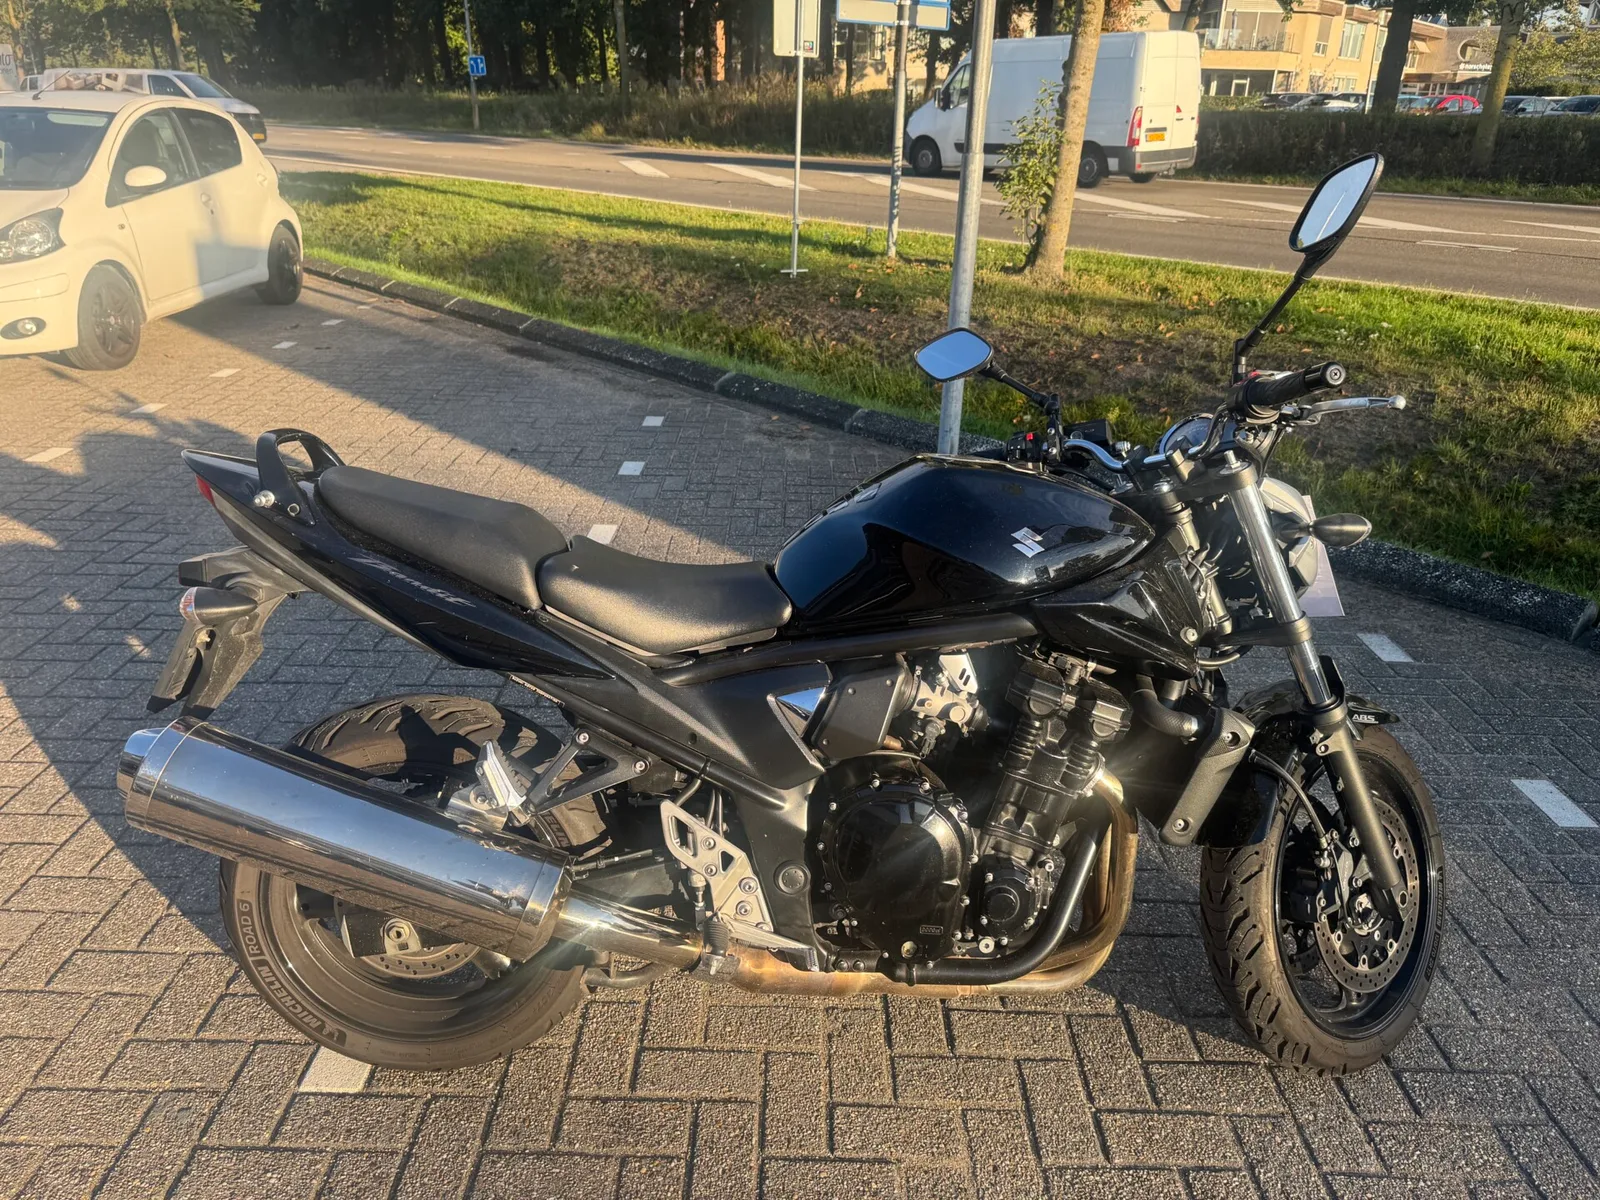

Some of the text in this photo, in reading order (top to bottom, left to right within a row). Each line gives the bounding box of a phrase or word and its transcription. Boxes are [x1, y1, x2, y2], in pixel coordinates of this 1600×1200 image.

[1352, 713, 1375, 721] ABS
[542, 811, 571, 847] ELIN
[239, 902, 260, 954] ROAD 6
[257, 966, 322, 1029] MICHELIN
